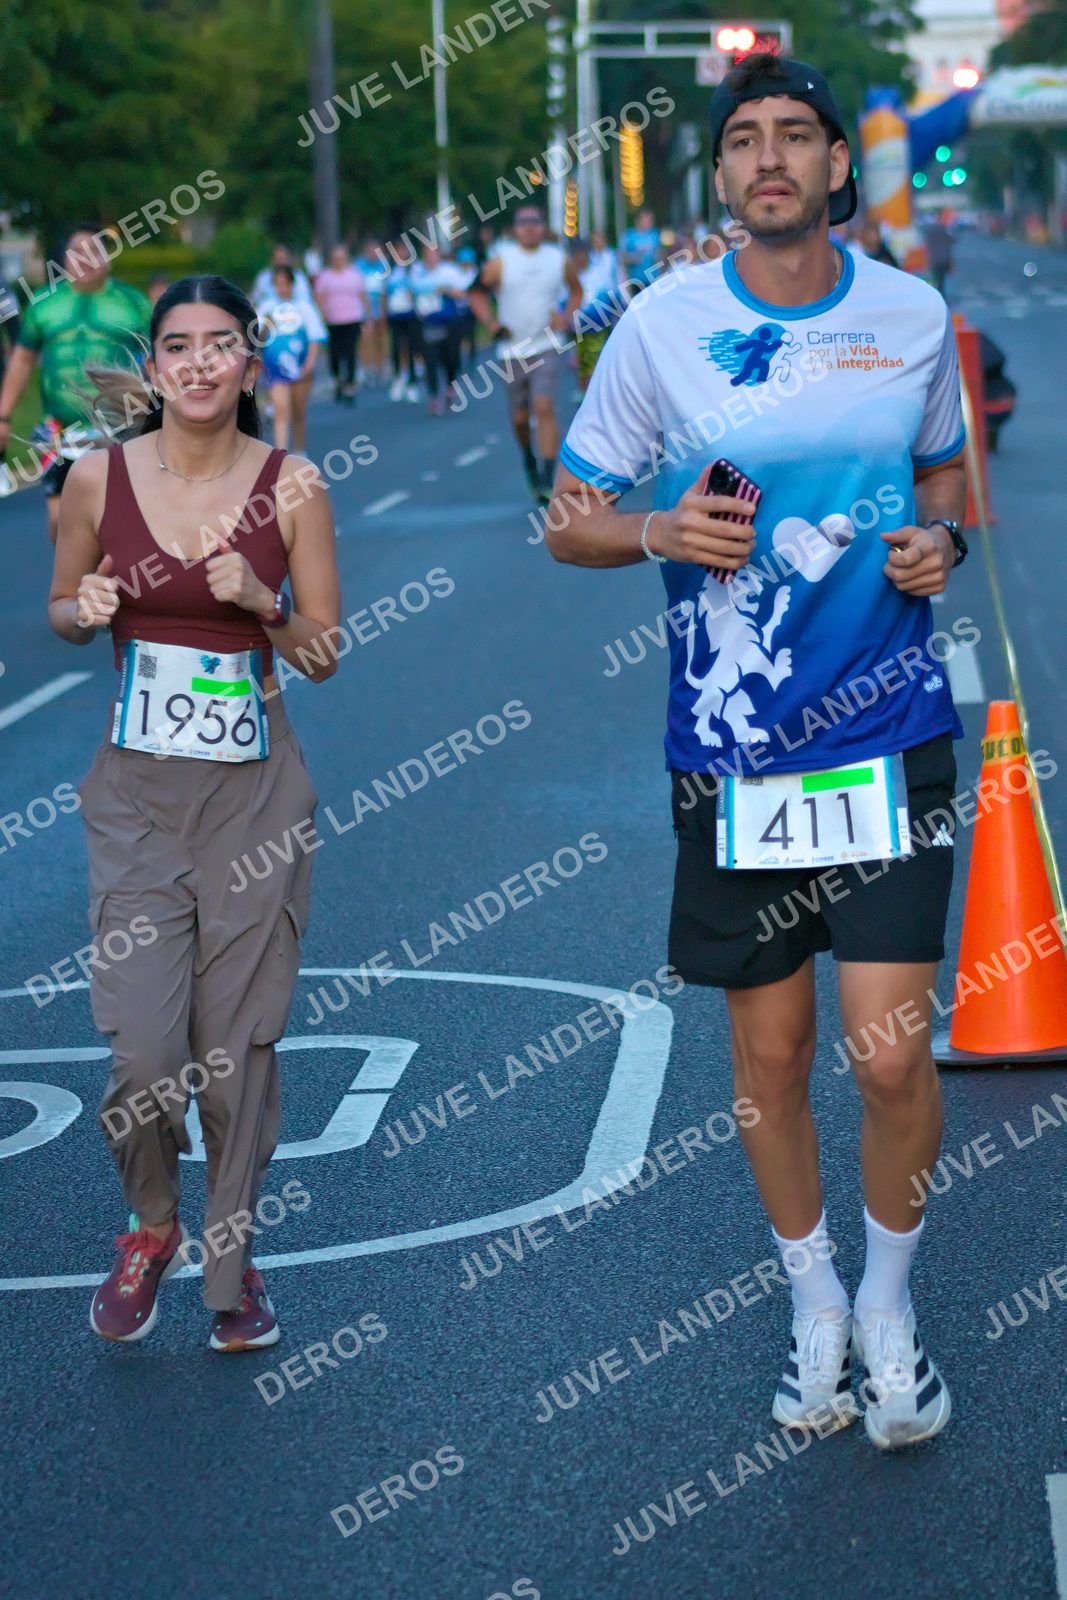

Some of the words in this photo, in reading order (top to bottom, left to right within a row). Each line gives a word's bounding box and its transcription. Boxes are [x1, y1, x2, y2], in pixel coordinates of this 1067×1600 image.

[807, 331, 875, 344] Carrera
[809, 348, 831, 360] por
[835, 345, 847, 357] la
[849, 345, 879, 356] Vida
[836, 357, 904, 371] Integridad
[138, 690, 257, 747] 1956
[758, 792, 855, 850] 411
